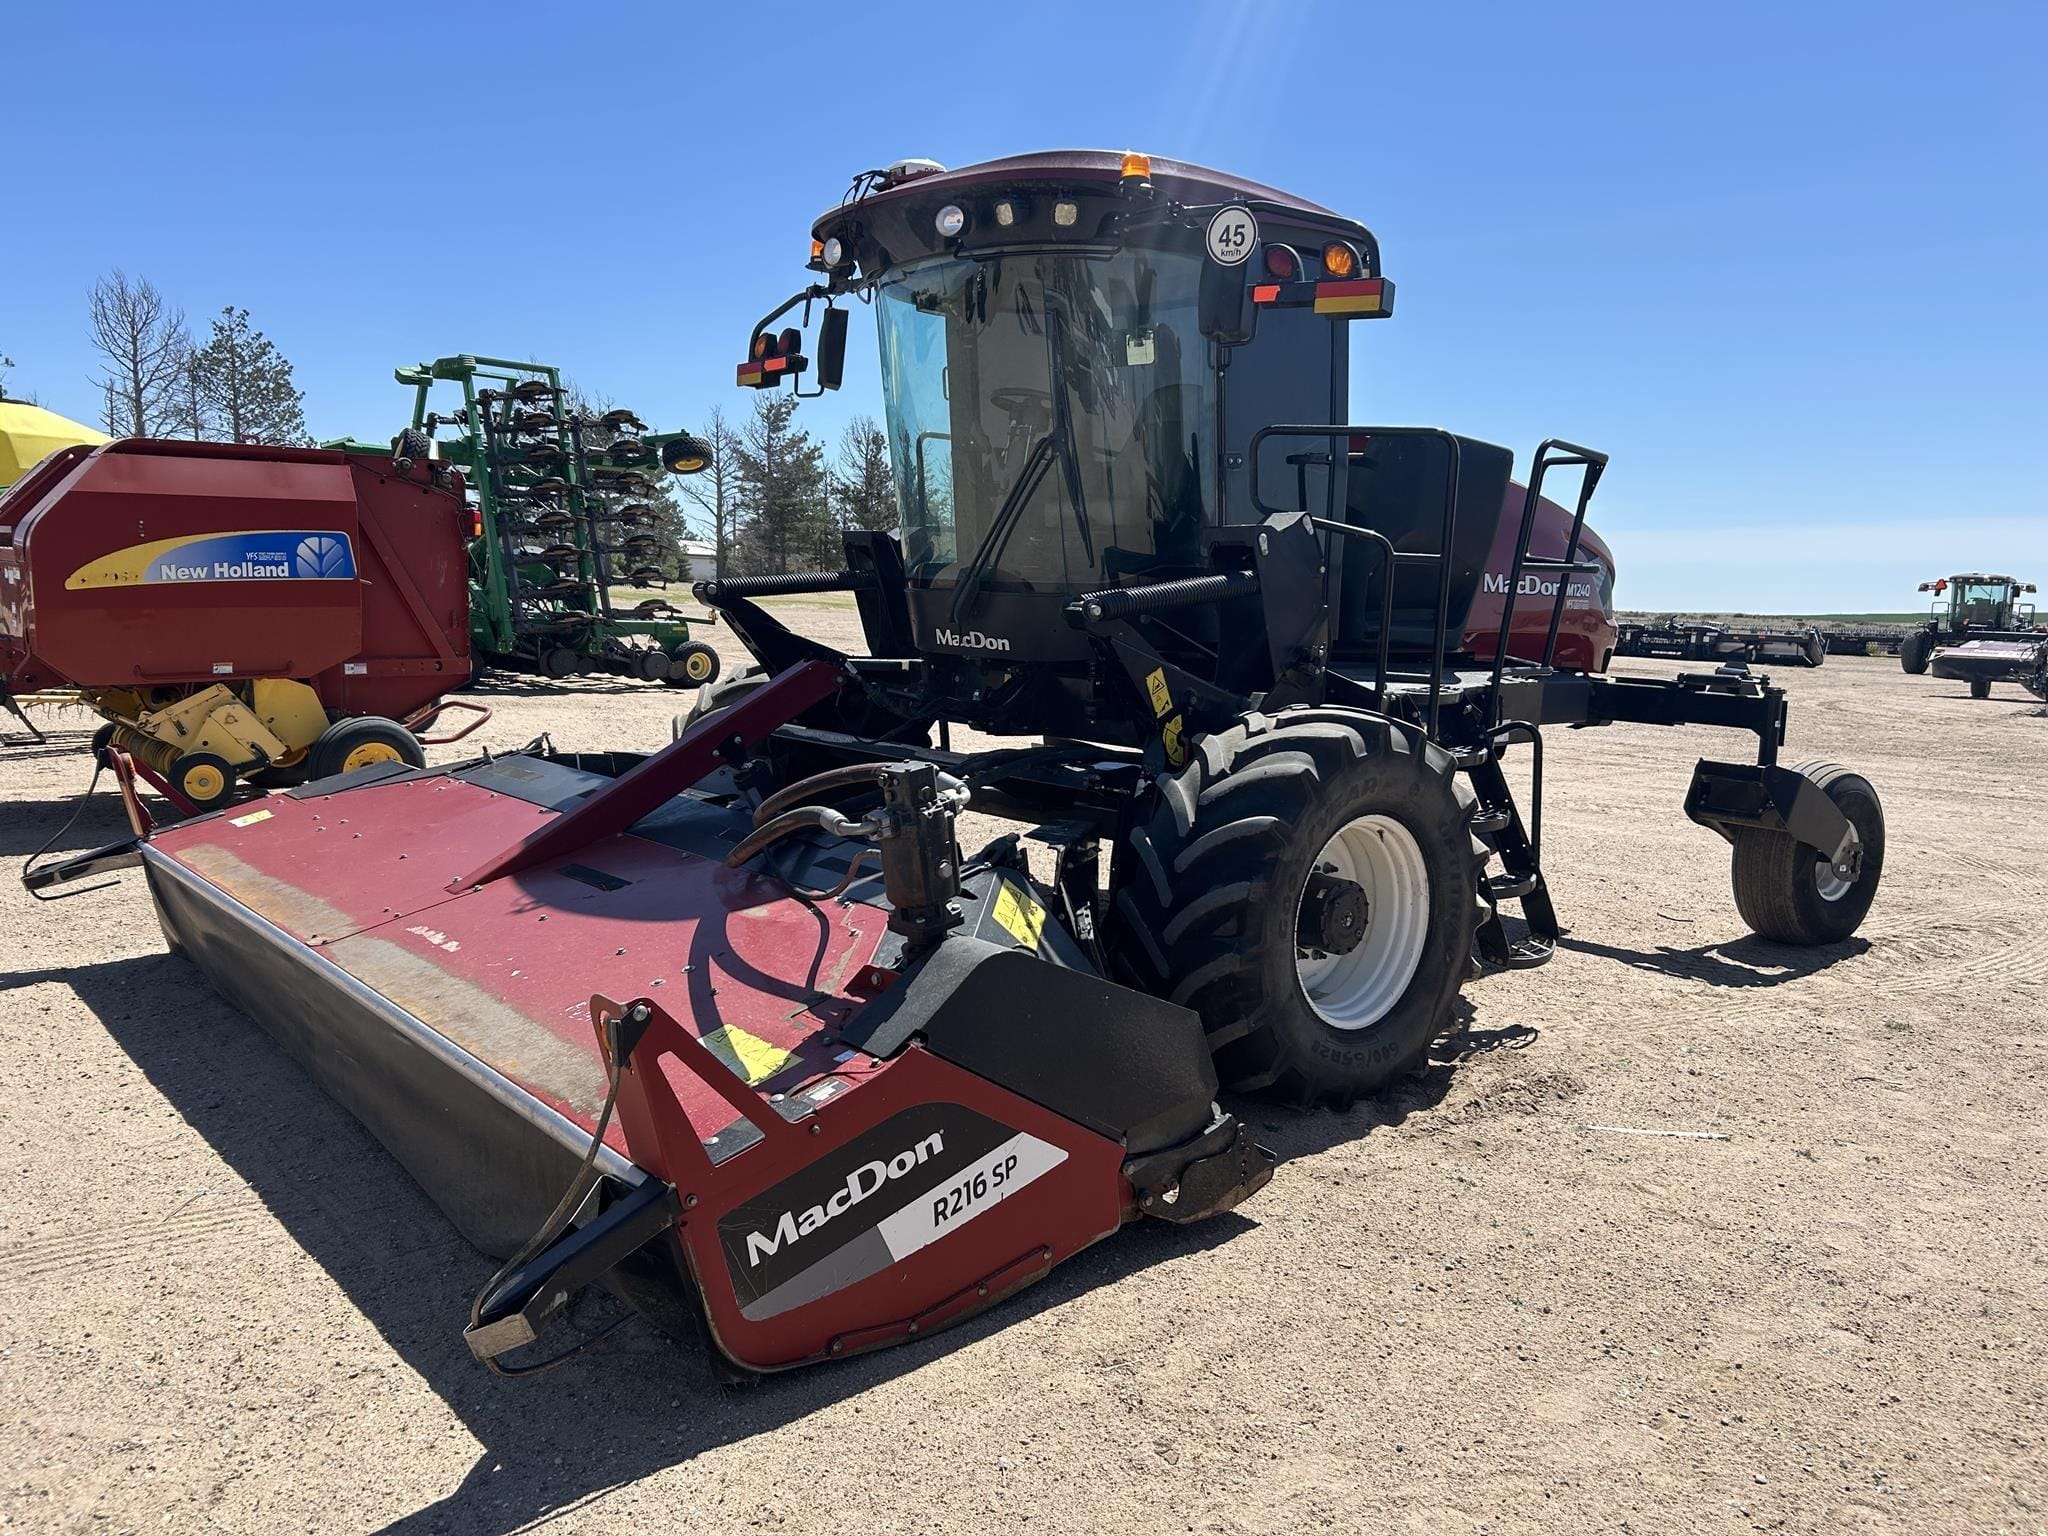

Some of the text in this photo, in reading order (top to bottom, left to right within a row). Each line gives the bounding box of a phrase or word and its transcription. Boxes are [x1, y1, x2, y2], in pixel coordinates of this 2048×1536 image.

[1218, 224, 1245, 247] 45
[1221, 248, 1241, 257] km/h
[160, 562, 289, 580] New Holland
[935, 628, 1010, 651] MacDon
[746, 1130, 944, 1268] MacDon
[933, 1155, 1019, 1228] R216 SP
